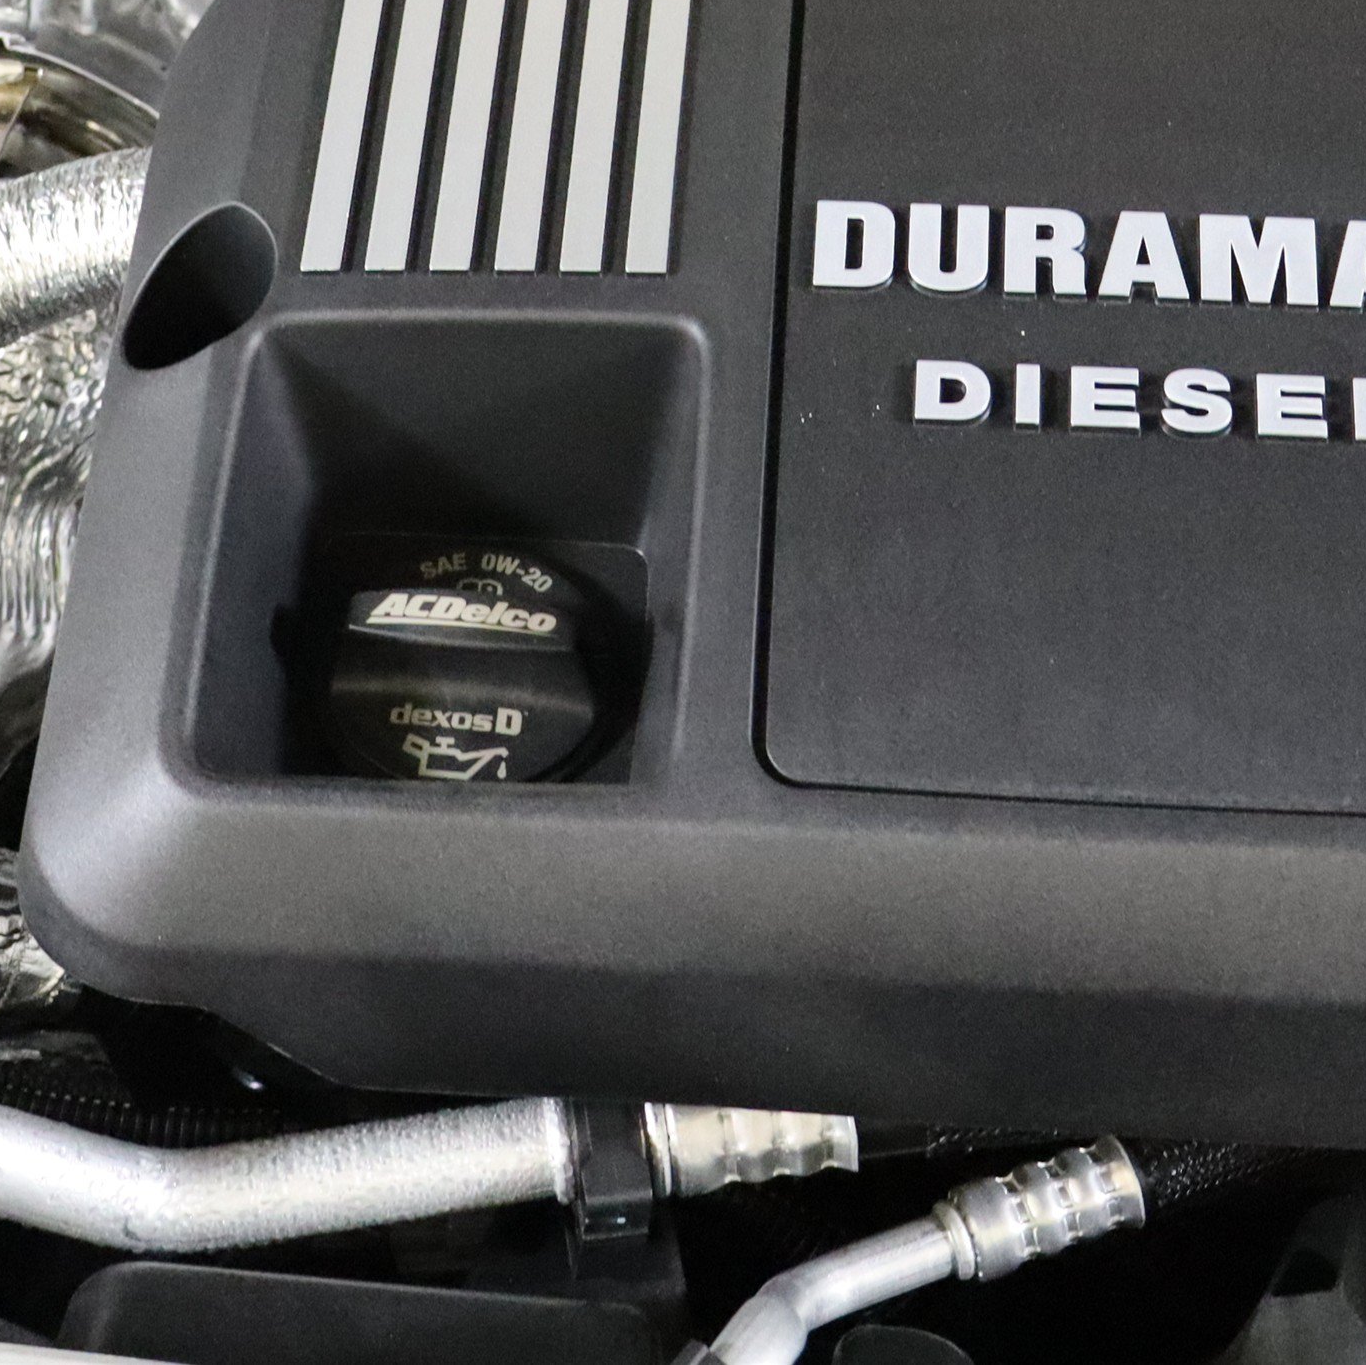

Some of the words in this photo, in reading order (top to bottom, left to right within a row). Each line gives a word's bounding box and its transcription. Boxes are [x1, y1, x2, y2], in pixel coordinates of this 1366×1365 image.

[420, 553, 467, 578] SAE
[481, 553, 554, 593] 0W-20
[369, 592, 558, 634] ACDelco
